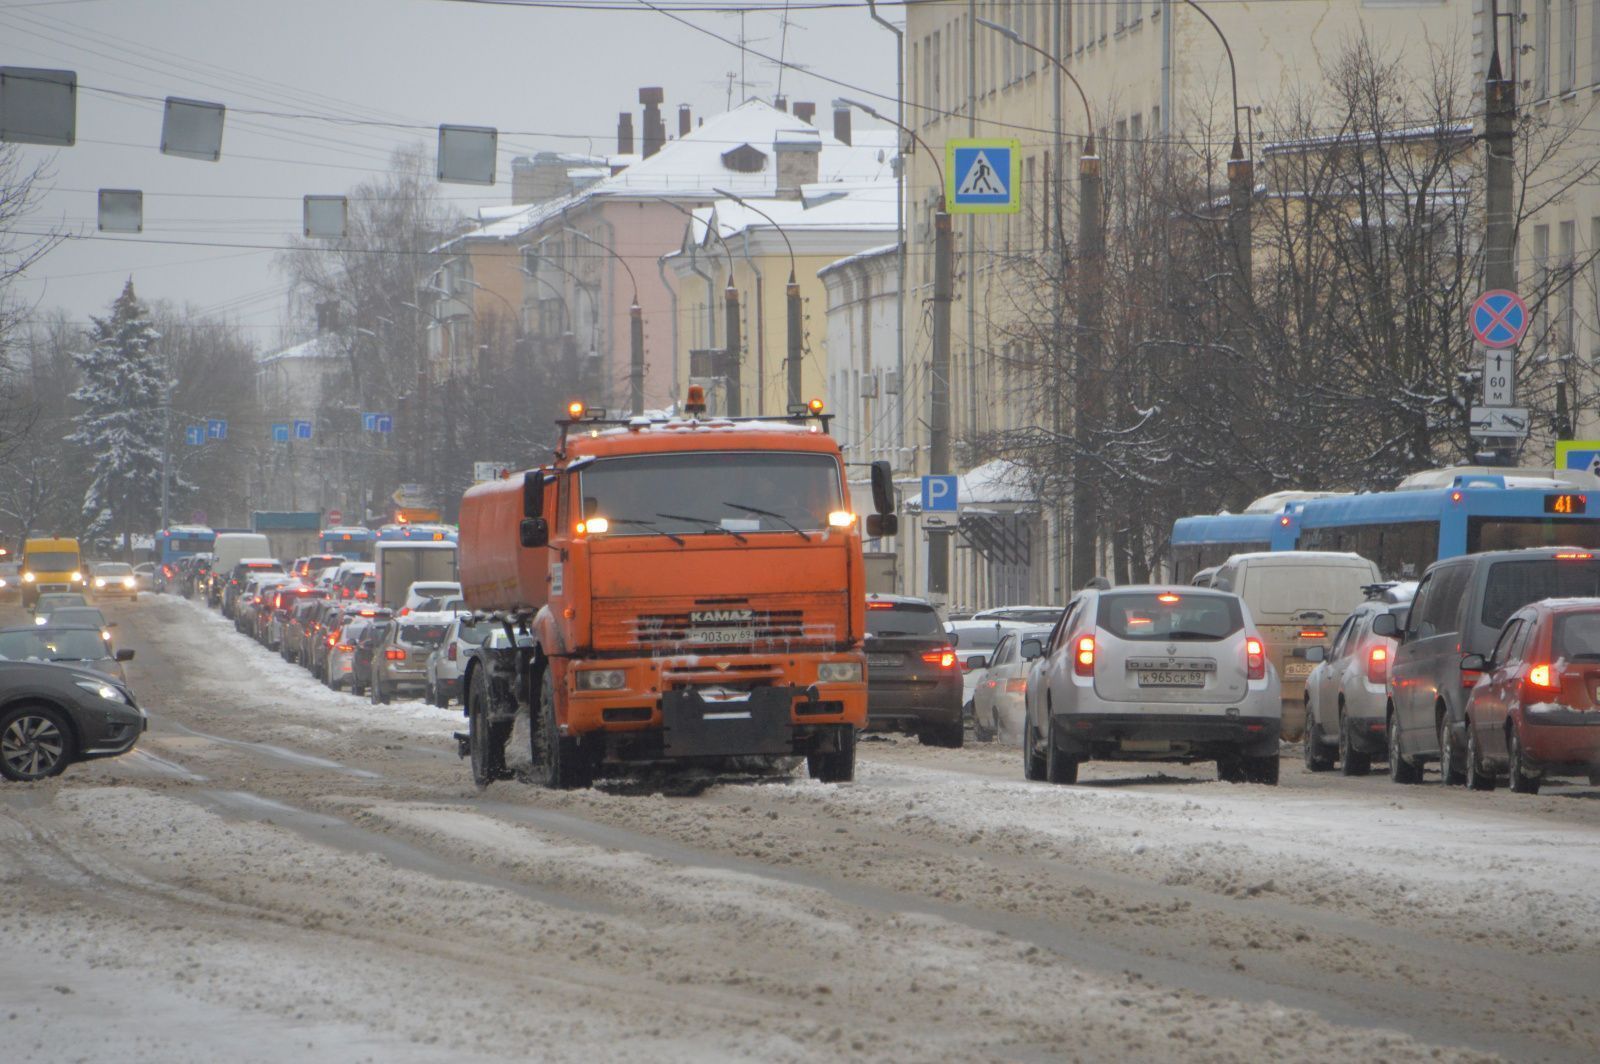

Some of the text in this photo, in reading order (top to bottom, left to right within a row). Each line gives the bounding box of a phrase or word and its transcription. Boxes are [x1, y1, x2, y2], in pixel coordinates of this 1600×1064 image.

[1490, 376, 1506, 388] 60
[928, 479, 949, 507] P
[1554, 495, 1572, 513] 41
[690, 610, 753, 622] KAMAZ
[1130, 662, 1214, 670] DUSTER
